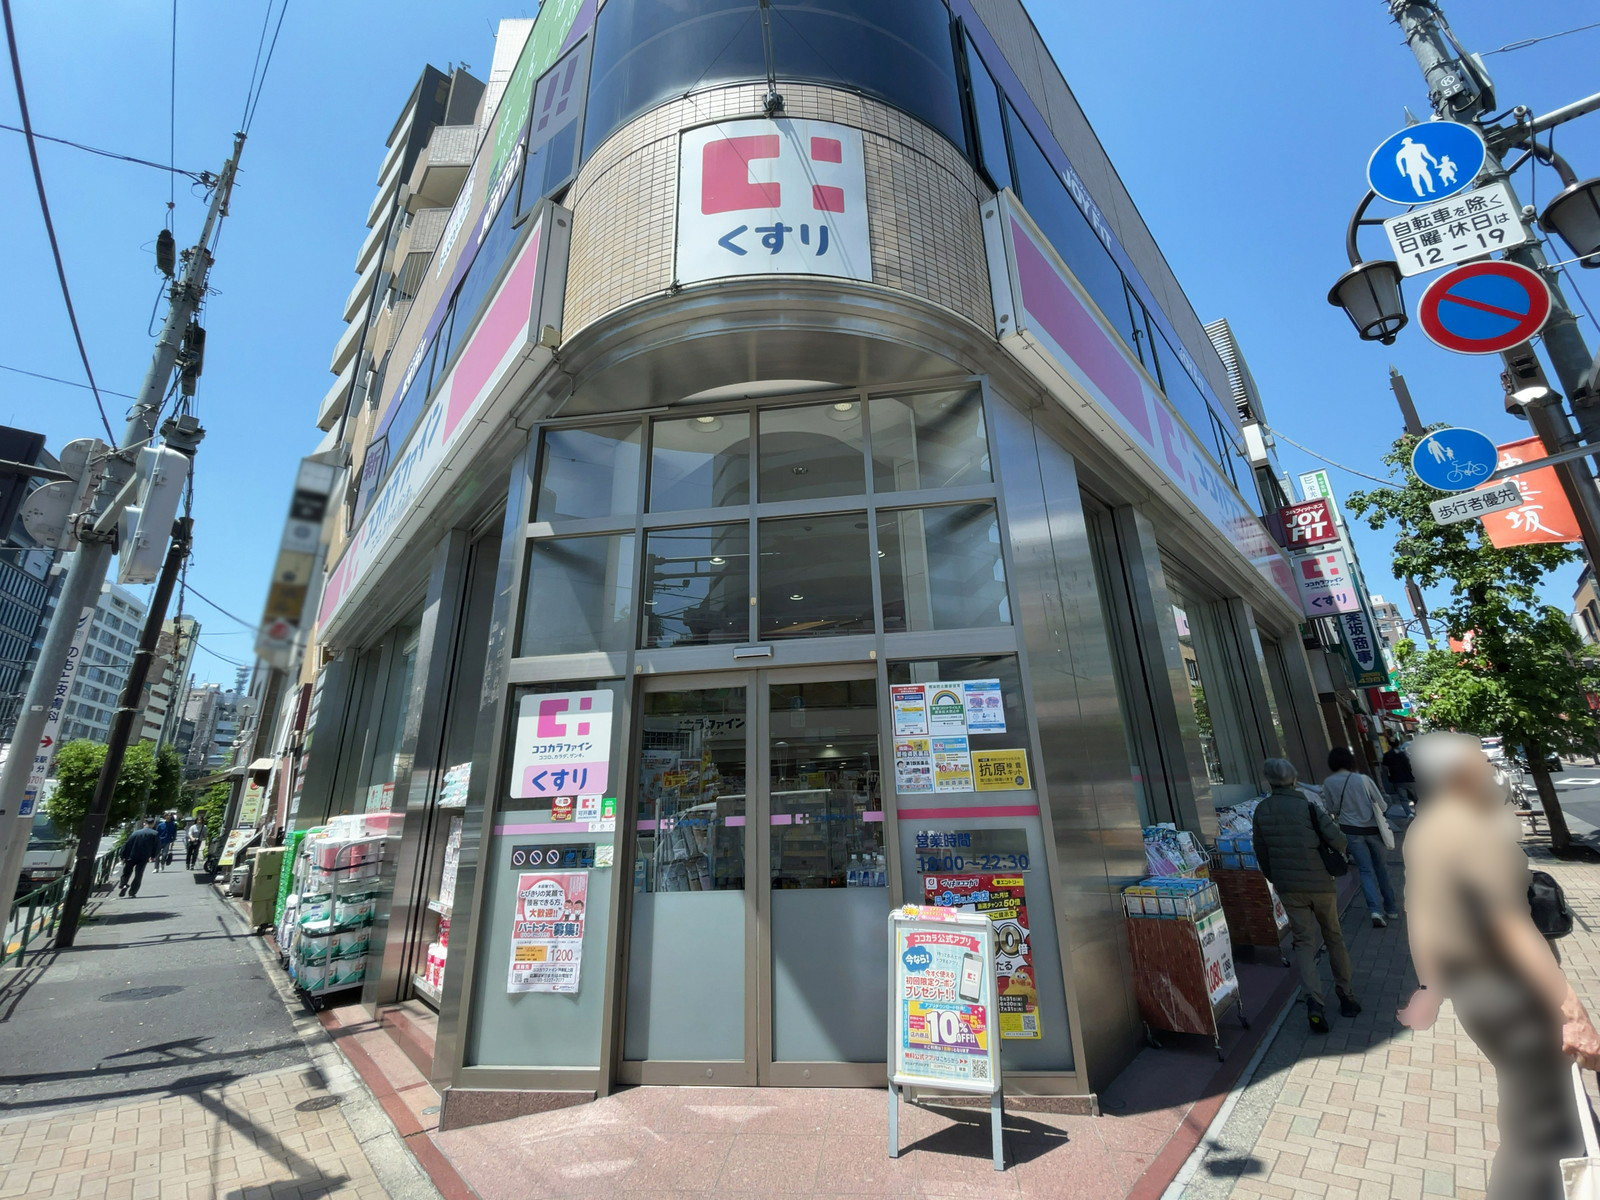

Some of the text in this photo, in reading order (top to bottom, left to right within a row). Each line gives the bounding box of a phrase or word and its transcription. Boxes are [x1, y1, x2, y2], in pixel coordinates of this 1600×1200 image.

[1393, 193, 1504, 237] 自転車を除く
[718, 222, 829, 256] くすり
[364, 402, 443, 548] ココカラファイン
[1438, 488, 1516, 520] 歩行者優先
[1286, 509, 1325, 528] JOY
[1292, 521, 1327, 542] FIT
[1305, 577, 1343, 588] ココカラファイン
[1312, 593, 1346, 608] くすり
[532, 742, 592, 754] ココカラファイン
[979, 762, 1006, 777] 抗原
[532, 768, 587, 791] くすり
[916, 832, 971, 848] 営業時間
[520, 890, 563, 898] とびきりの笑顔で
[529, 908, 558, 918] 大歓迎!!
[914, 934, 972, 946] ココカラ公式アプリ
[550, 949, 574, 961] 1200
[905, 954, 930, 965] 今なら!
[925, 970, 955, 978] 今すぐ使える
[906, 976, 955, 988] 初回限定クーポン
[905, 986, 955, 999] プレゼント!!
